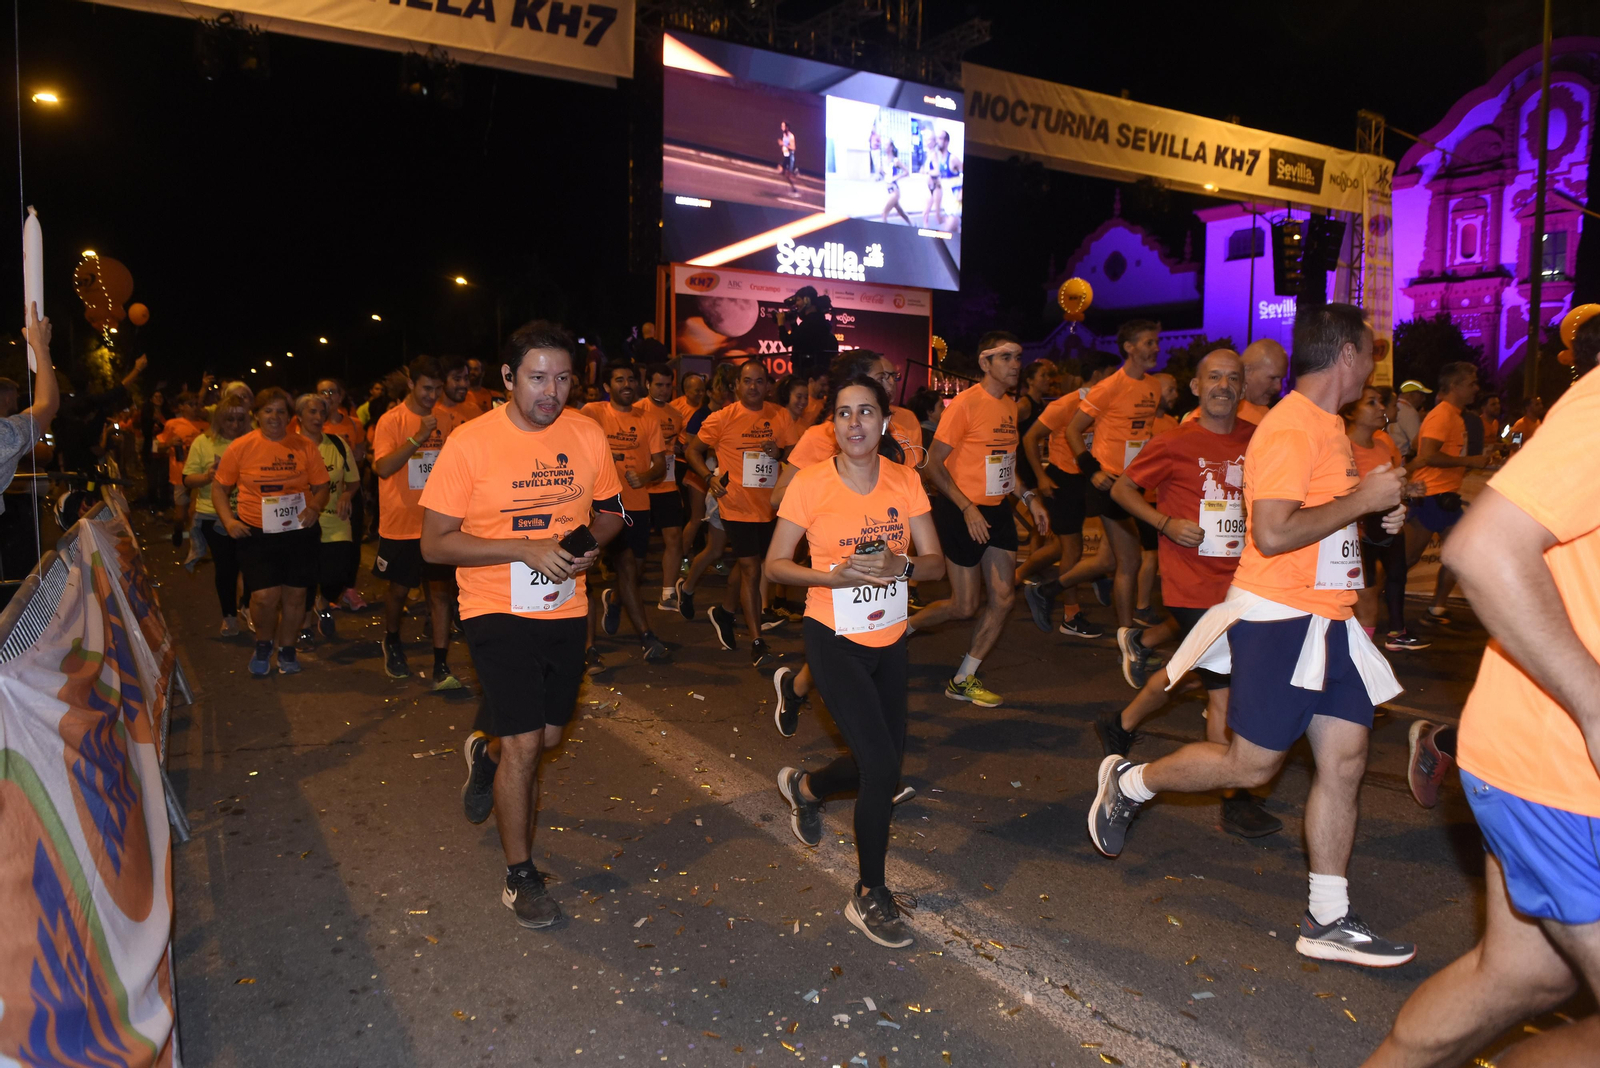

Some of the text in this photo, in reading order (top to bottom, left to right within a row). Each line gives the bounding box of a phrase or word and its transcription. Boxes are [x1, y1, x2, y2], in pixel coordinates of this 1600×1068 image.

[968, 91, 1109, 144] NOCTURNA
[1115, 123, 1208, 165] SEVILLA
[726, 279, 743, 289] ABC
[418, 463, 435, 474] 136
[531, 469, 575, 479] NOCTURNA
[755, 464, 773, 474] 5415
[999, 466, 1012, 479] 2751
[511, 479, 554, 489] SEVILLA
[273, 505, 299, 518] 12971
[860, 523, 904, 535] NOCTURNA
[838, 535, 883, 547] SEVILLA
[530, 571, 556, 586] 20
[851, 580, 898, 604] 20773
